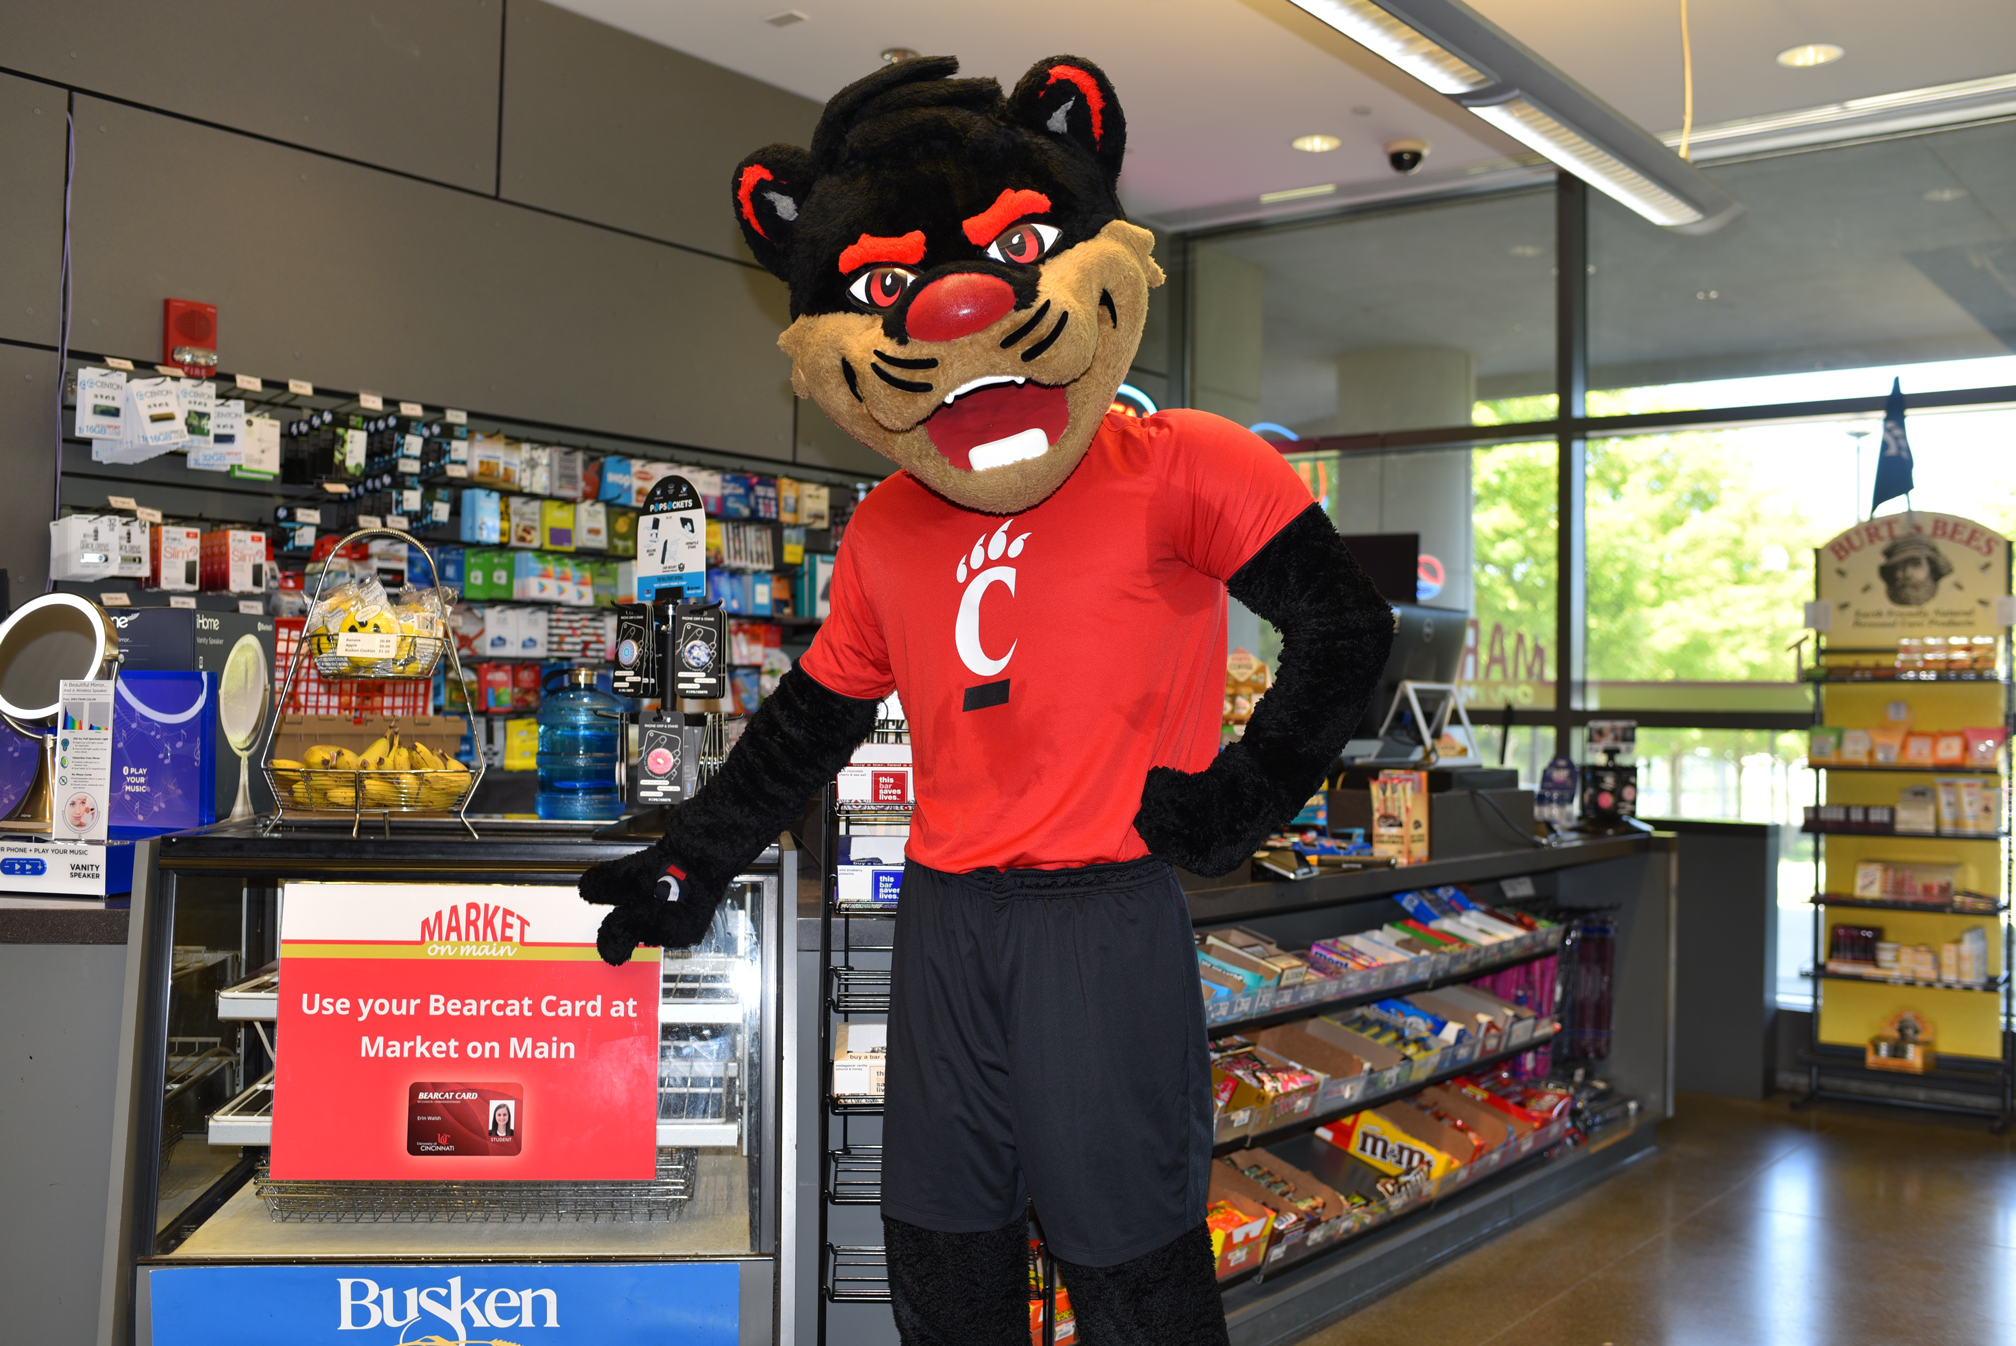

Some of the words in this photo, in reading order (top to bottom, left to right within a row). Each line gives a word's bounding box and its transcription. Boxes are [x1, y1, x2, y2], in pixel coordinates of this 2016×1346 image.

[184, 366, 206, 376] FIRE
[95, 380, 123, 391] CENTON
[144, 389, 172, 398] CENTON
[189, 390, 213, 400] CENTON
[85, 424, 107, 435] 16GB
[150, 432, 172, 443] 16GB
[1931, 517, 2000, 557] BEES
[164, 545, 189, 560] Slim
[232, 548, 256, 563] Slim
[196, 614, 219, 630] iHome
[196, 637, 212, 646] Vanity
[213, 637, 224, 646] Speaker
[70, 864, 100, 872] VANITY
[420, 902, 530, 944] MARKET
[427, 944, 457, 956] on
[460, 942, 517, 957] main
[302, 993, 350, 1015] Use
[358, 998, 421, 1022] your
[429, 994, 532, 1016] Bearcat
[541, 995, 602, 1017] Card
[610, 998, 638, 1017] at
[361, 1035, 459, 1058] Market
[466, 1041, 500, 1058] on
[509, 1036, 575, 1059] Main
[418, 1092, 454, 1100] BEARCAT
[455, 1092, 478, 1100] CARD
[337, 1275, 560, 1330] Busken
